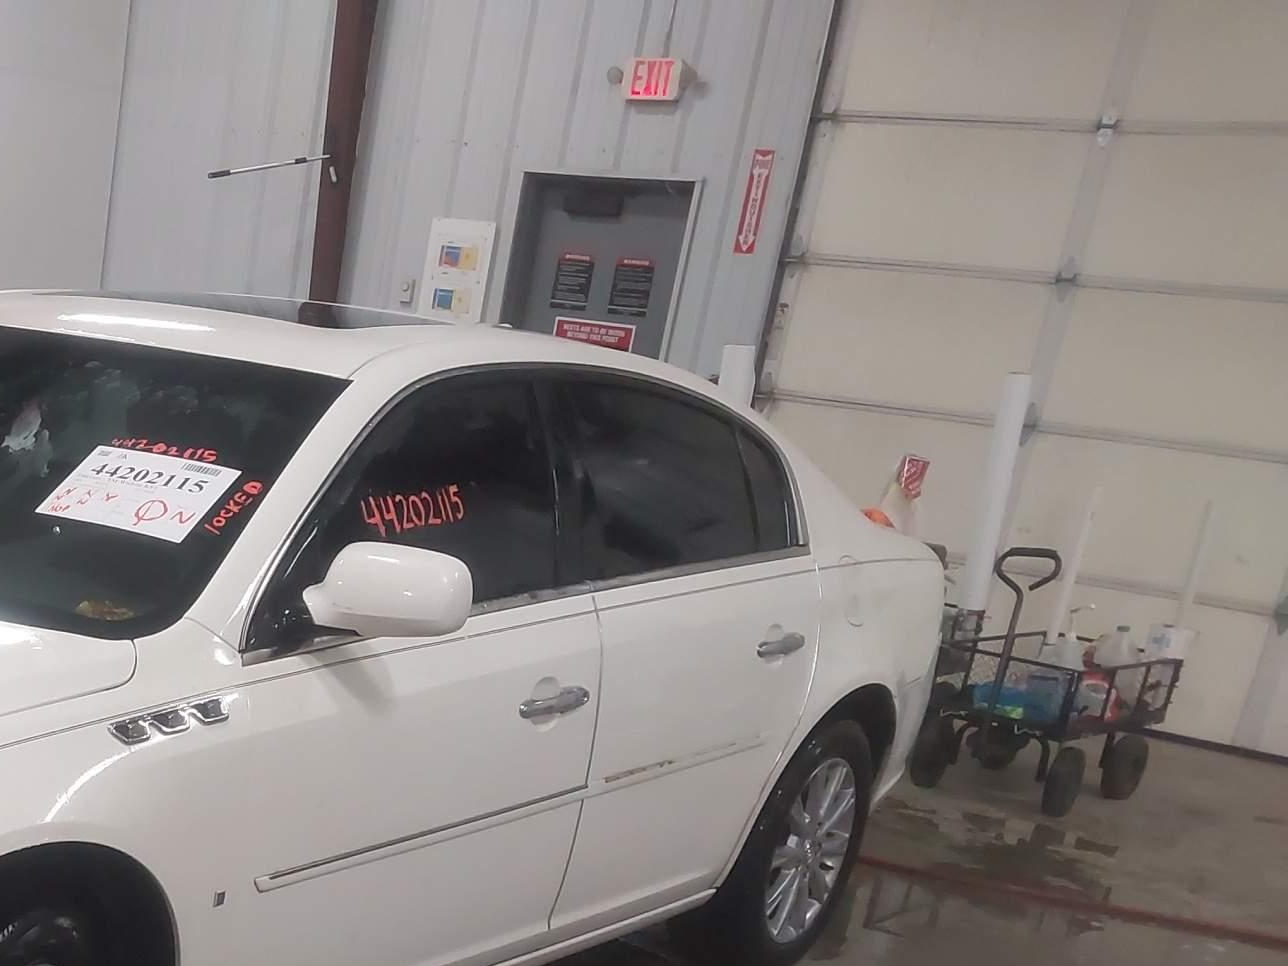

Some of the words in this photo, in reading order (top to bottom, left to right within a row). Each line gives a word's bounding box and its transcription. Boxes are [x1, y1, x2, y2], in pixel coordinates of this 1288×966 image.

[631, 60, 675, 96] EXIT
[112, 438, 217, 462] 44202115
[91, 463, 209, 493] 44202115
[361, 484, 465, 537] 44202115
